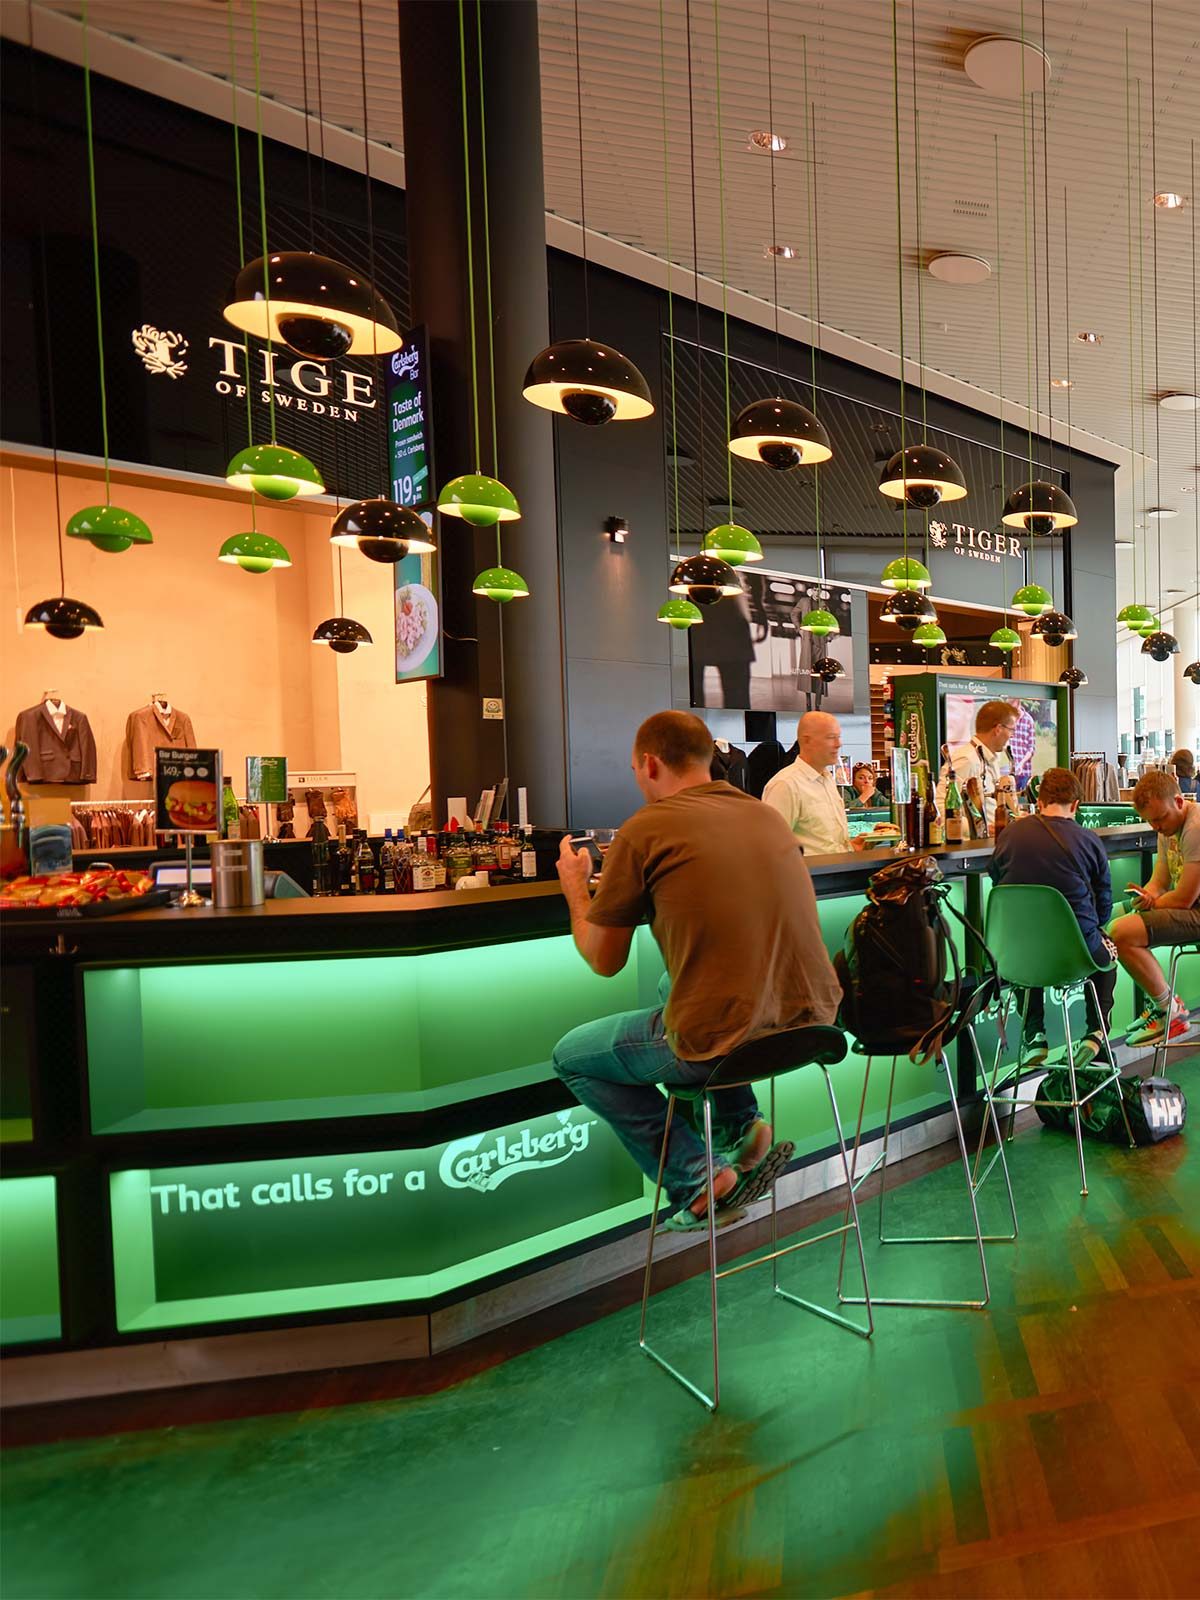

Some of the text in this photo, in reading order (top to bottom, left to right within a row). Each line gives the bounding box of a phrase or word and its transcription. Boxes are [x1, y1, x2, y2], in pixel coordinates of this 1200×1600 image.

[208, 337, 376, 408] TIGE
[391, 345, 419, 377] Carlsberg
[409, 369, 419, 380] Bar
[215, 381, 358, 422] OF SWEDEN
[393, 391, 422, 416] Taste of
[393, 408, 425, 433] Denmark
[952, 523, 1022, 559] TIGER
[954, 546, 1001, 563] OF SWEDEN
[159, 750, 198, 761] Bar Burger
[1149, 1097, 1182, 1127] HH
[150, 1109, 597, 1214] That calls for a Carlsberg
